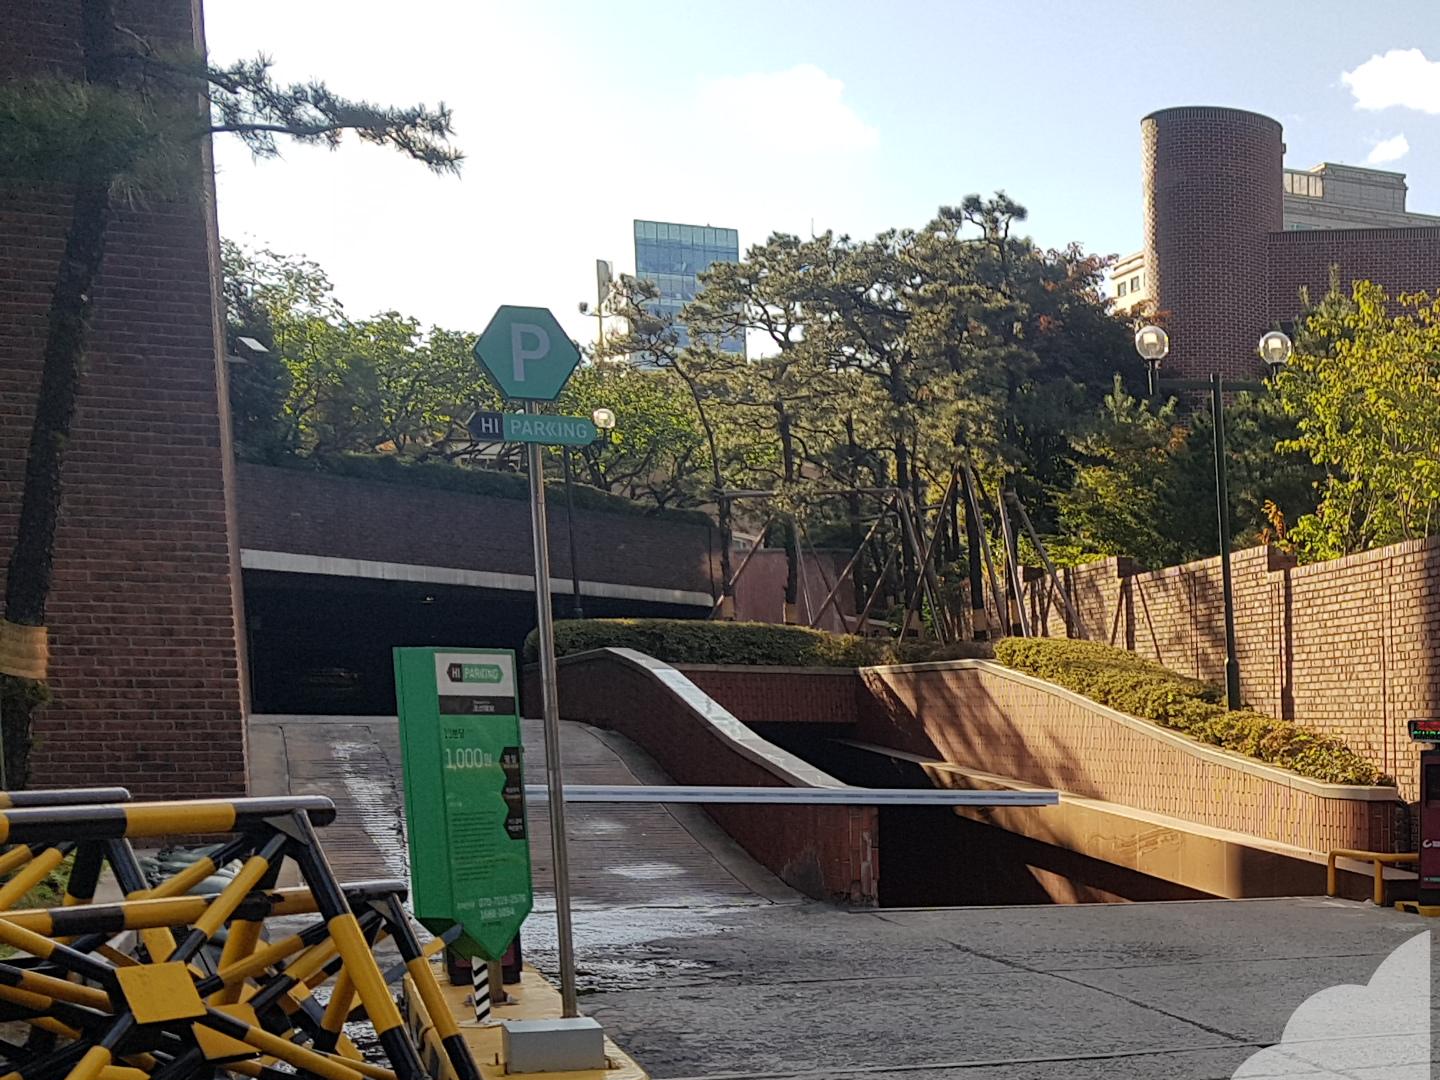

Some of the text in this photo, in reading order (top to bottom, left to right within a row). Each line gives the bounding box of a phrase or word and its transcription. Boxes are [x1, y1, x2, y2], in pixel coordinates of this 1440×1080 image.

[511, 322, 551, 382] P
[481, 417, 588, 439] HI PARKING
[451, 667, 499, 680] HI PARKING
